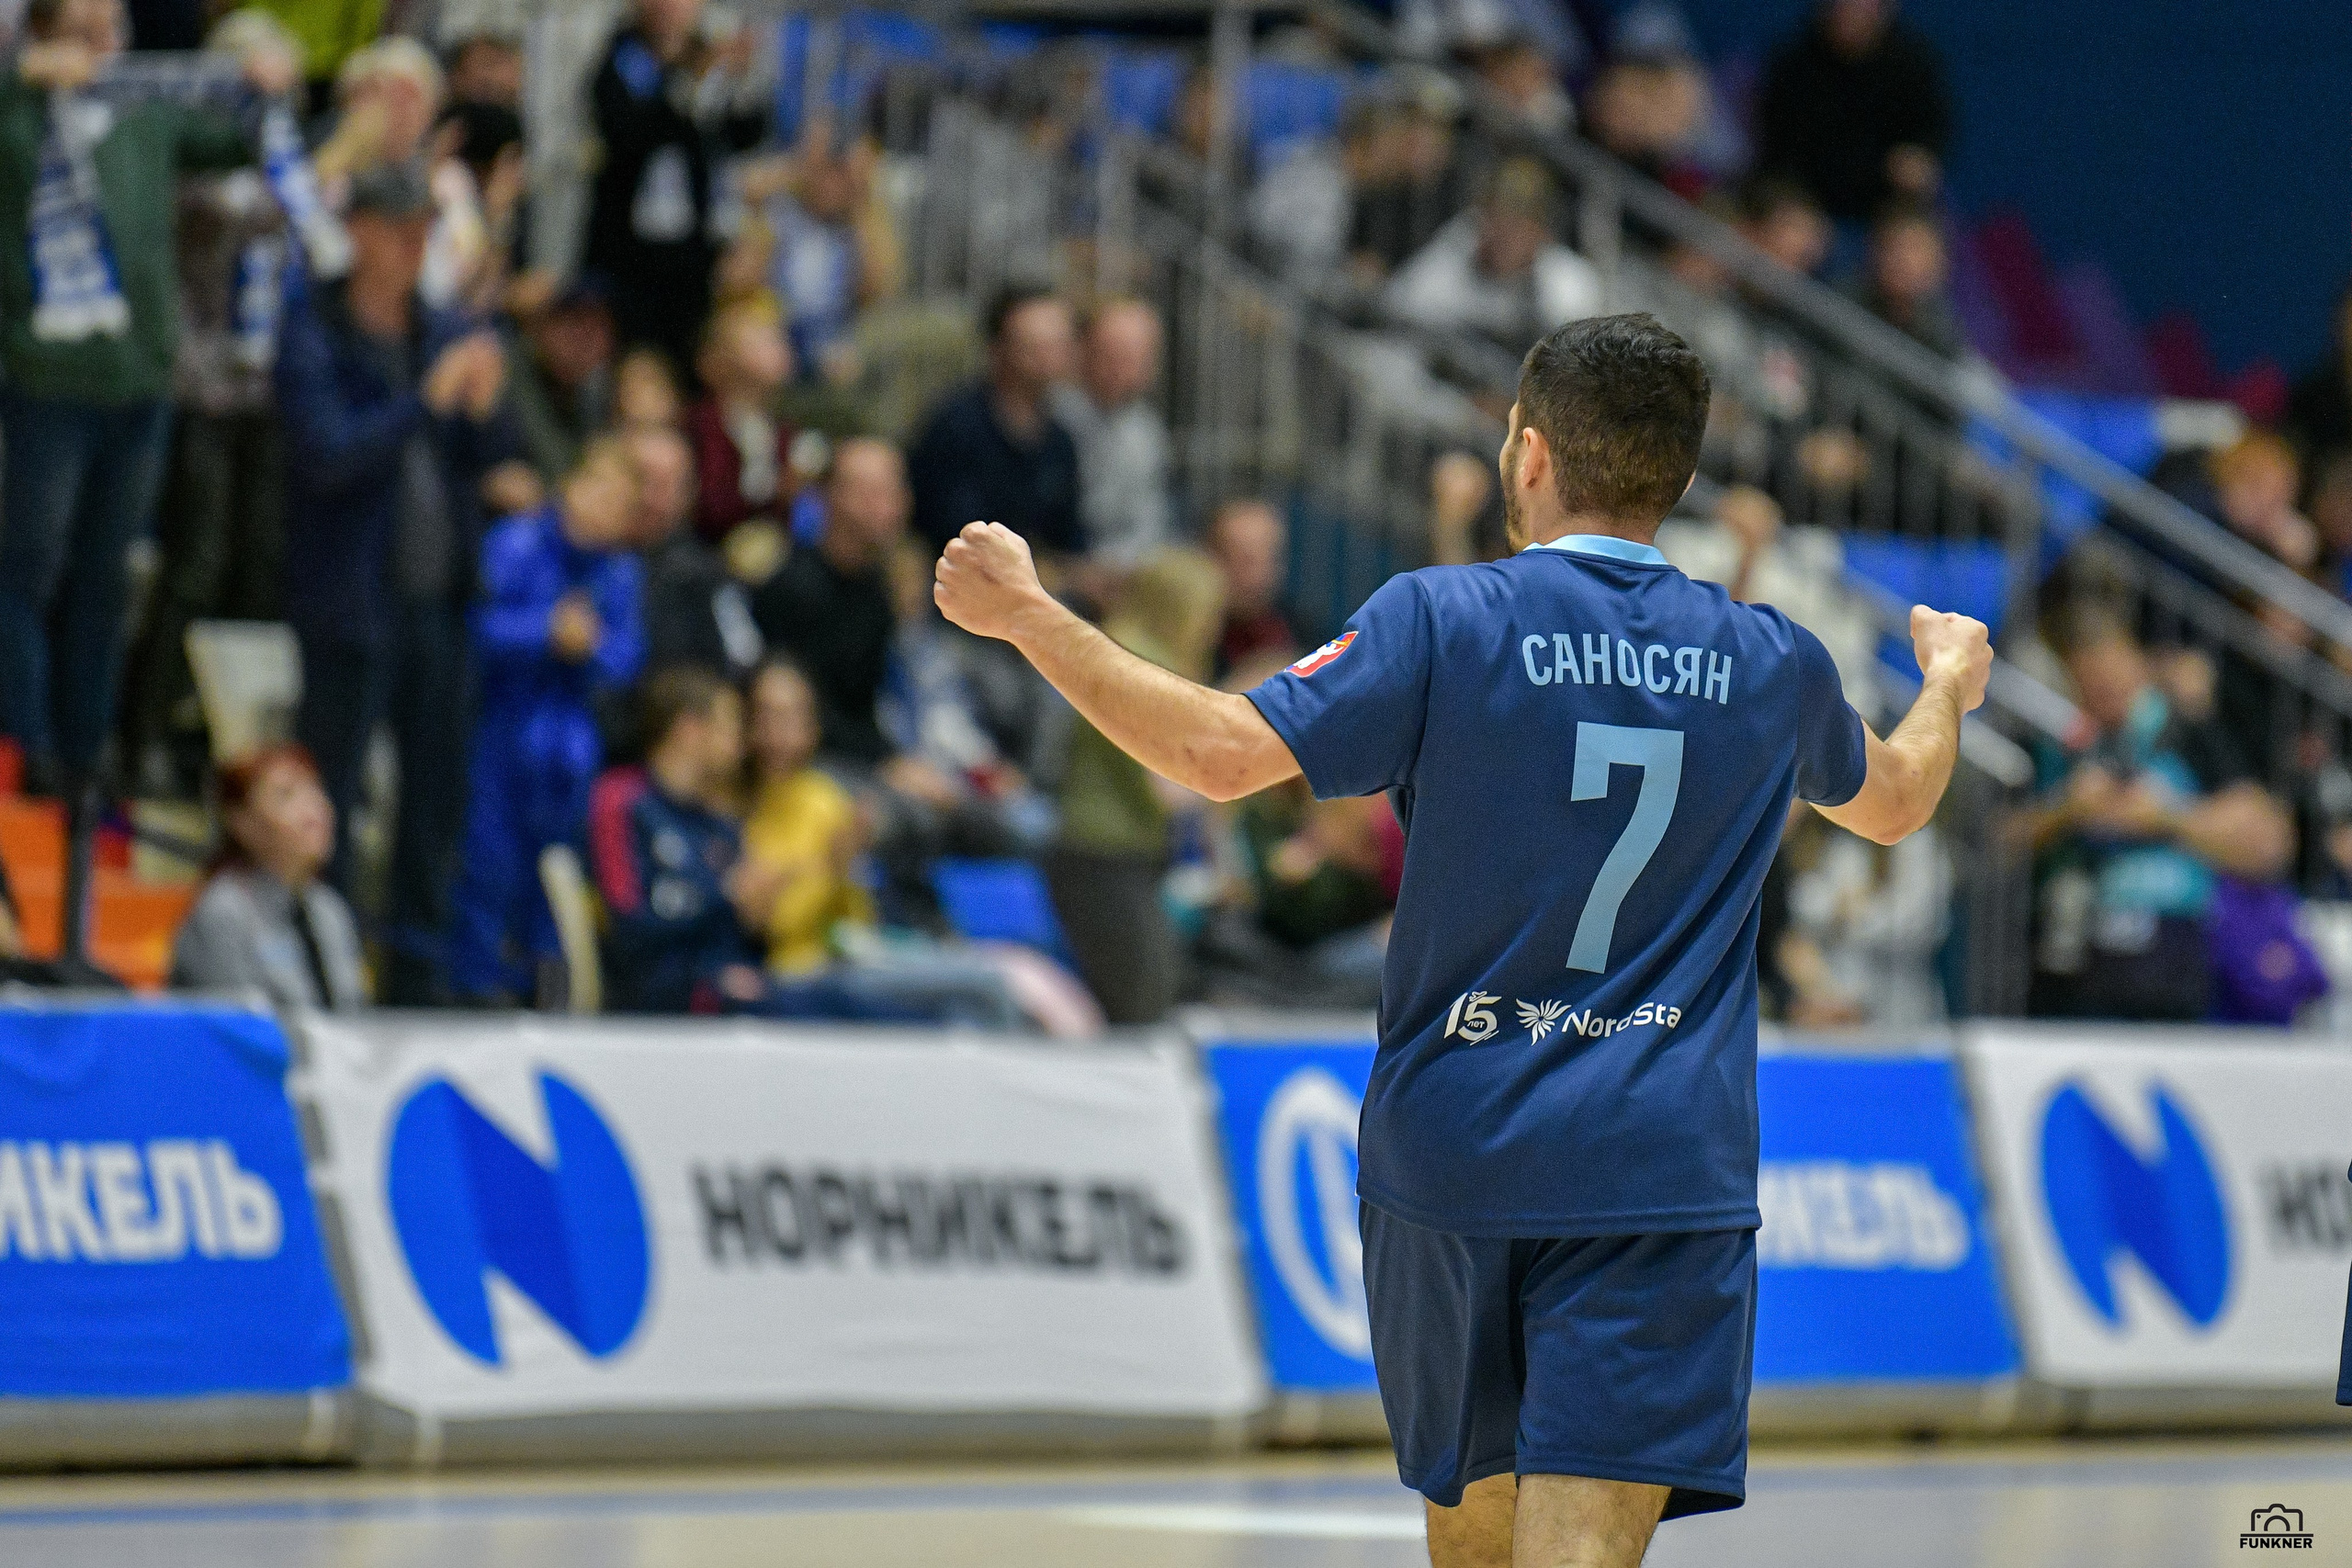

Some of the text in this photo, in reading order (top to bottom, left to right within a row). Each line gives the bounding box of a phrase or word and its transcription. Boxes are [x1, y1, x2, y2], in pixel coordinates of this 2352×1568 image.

[1522, 633, 1732, 705] САНОСЯН
[1566, 721, 1684, 974] 7
[1444, 992, 1501, 1042] 15
[695, 1161, 1187, 1277] НОРНИКЕЛЬ
